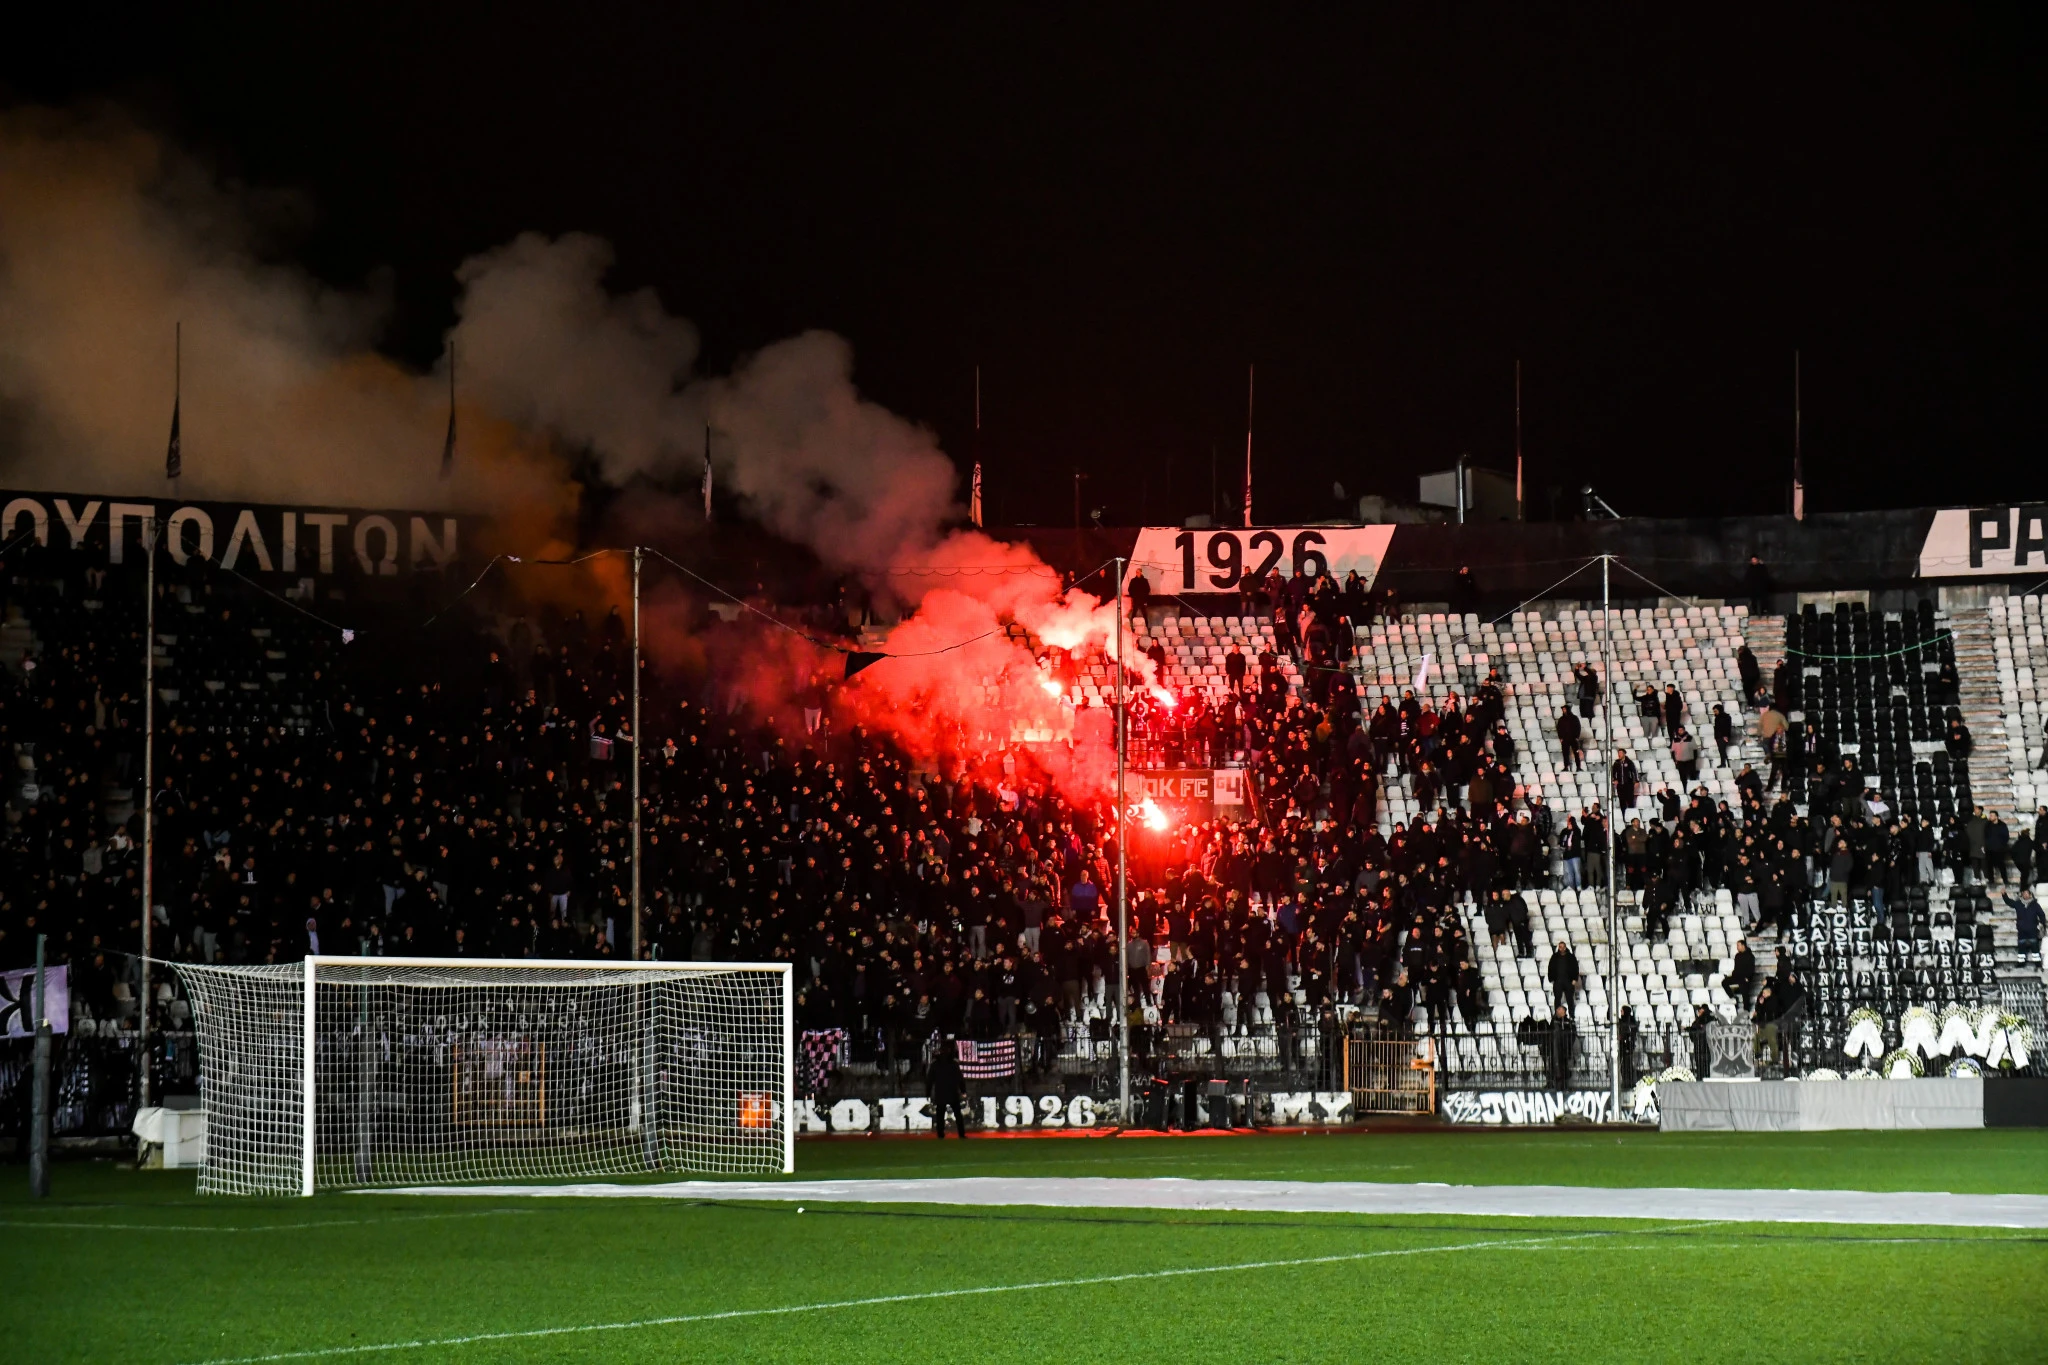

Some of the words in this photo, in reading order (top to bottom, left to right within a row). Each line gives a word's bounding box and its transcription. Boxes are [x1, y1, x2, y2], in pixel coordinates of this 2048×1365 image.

[1175, 530, 1327, 589] 1926
[1180, 778, 1208, 797] FC
[1792, 927, 1871, 942] EAST
[1794, 938, 1973, 956] OFFENDERS
[979, 1095, 1097, 1129] 1926
